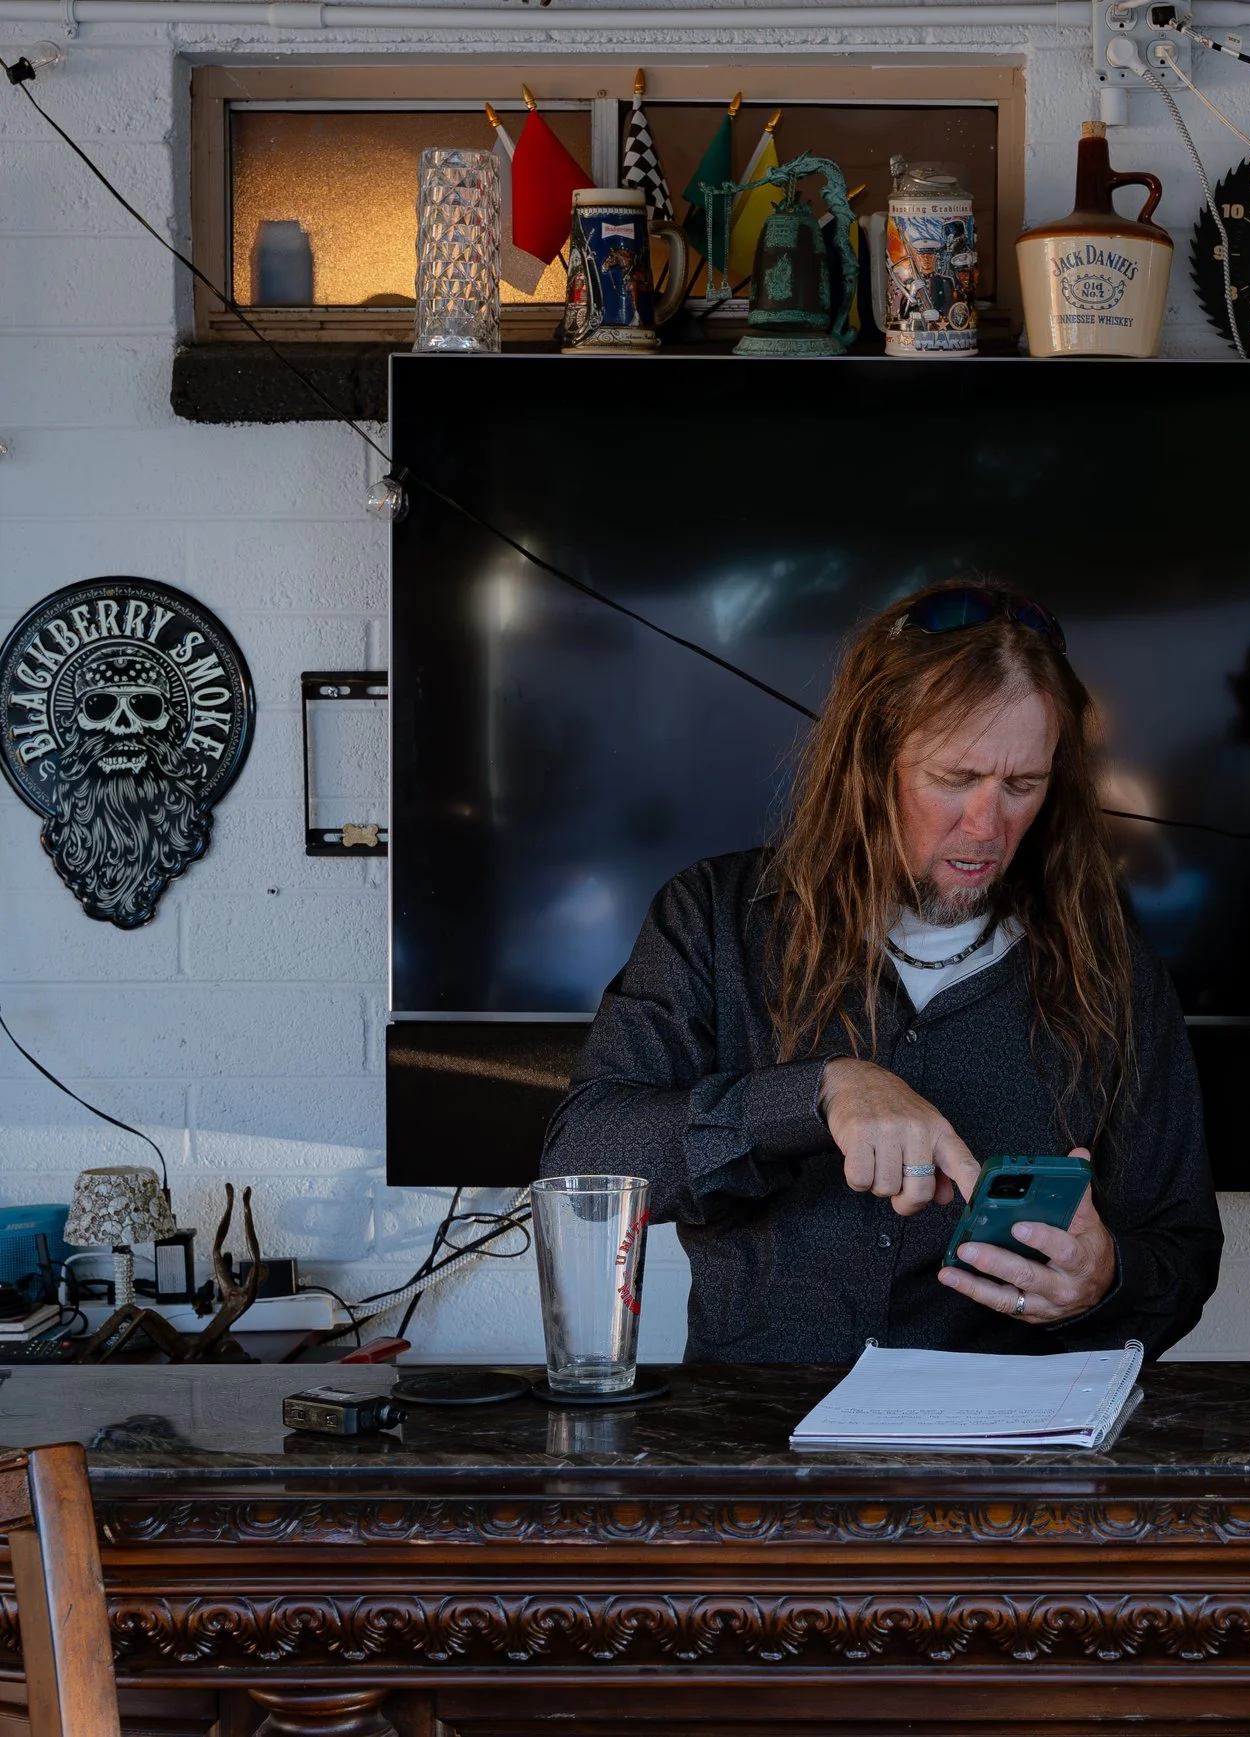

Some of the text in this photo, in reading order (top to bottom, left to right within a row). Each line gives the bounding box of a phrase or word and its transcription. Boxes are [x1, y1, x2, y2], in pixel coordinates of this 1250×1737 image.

[1221, 204, 1244, 219] 10
[1213, 245, 1227, 260] 9
[1050, 244, 1139, 281] JACK DANIEL'S
[1084, 282, 1103, 290] Old
[1082, 290, 1105, 298] No.7
[1053, 315, 1134, 328] ENNESSEE WHISKEY
[10, 599, 233, 765] BLACKBERRY SMOKE
